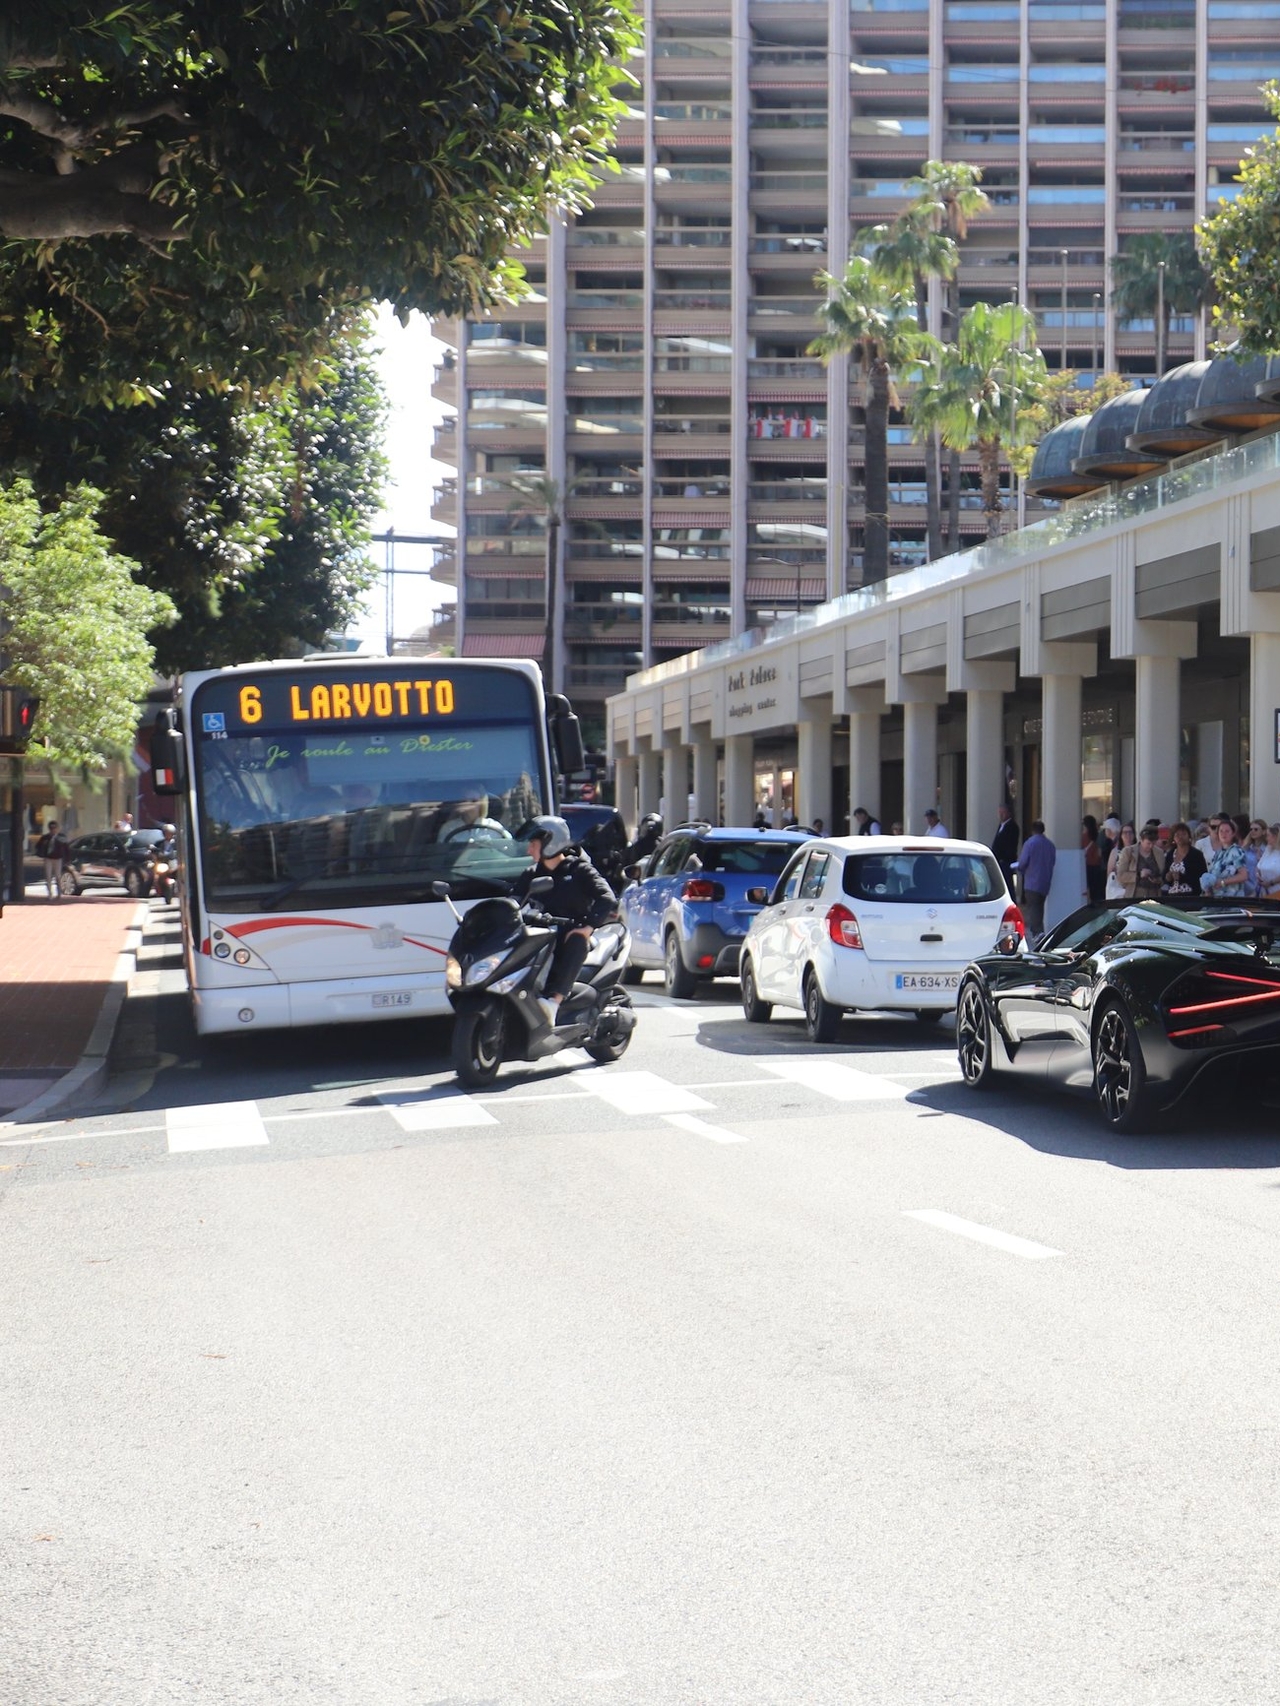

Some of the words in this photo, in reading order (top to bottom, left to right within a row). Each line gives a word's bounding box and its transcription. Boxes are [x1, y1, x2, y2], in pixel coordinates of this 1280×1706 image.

[239, 685, 262, 724] 6
[290, 679, 454, 720] LARVOTTO
[210, 732, 228, 740] 114
[265, 745, 290, 768] Je
[301, 740, 353, 757] roule
[363, 746, 390, 755] au
